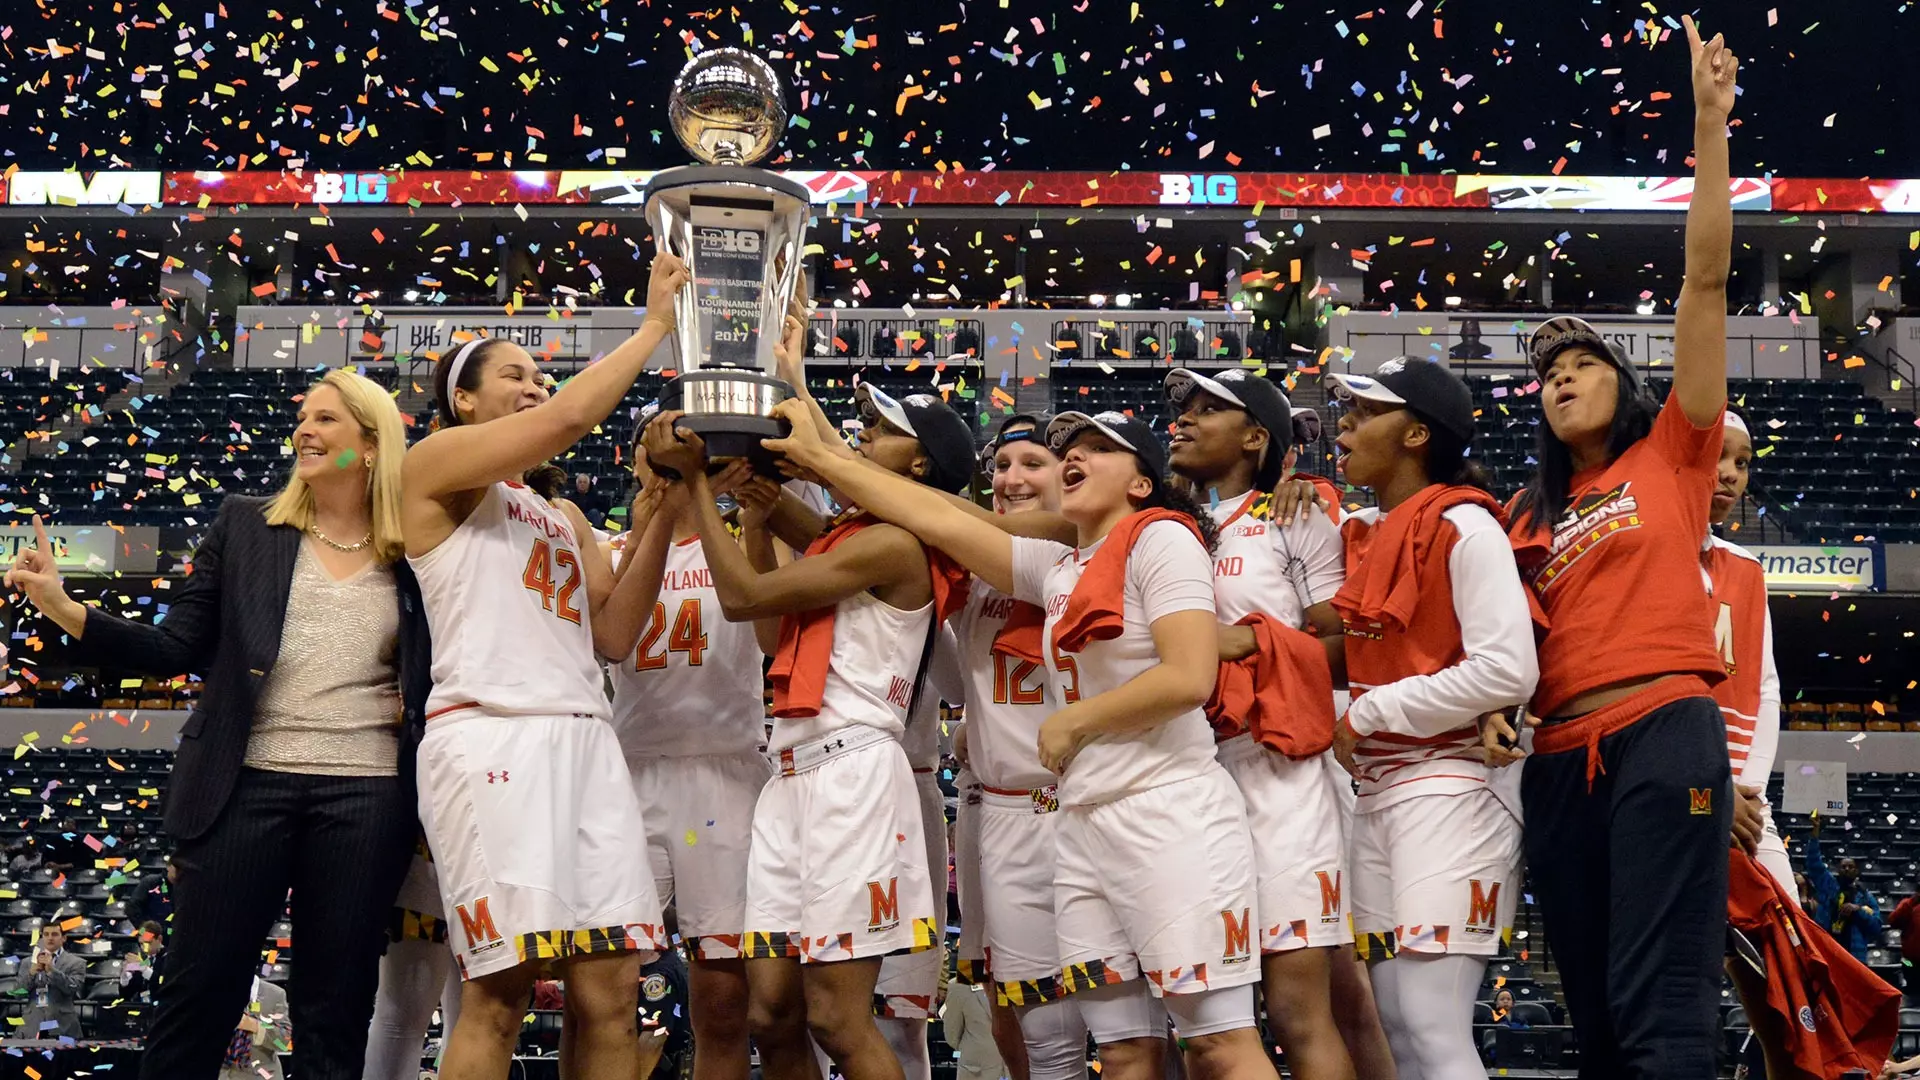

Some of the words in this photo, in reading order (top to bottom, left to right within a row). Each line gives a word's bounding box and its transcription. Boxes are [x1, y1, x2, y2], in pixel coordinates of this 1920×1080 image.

[715, 330, 748, 343] 2017
[522, 538, 582, 627] 42
[635, 598, 709, 673] 24
[1689, 787, 1712, 811] M
[866, 876, 900, 926] M
[1314, 869, 1342, 917] M
[1466, 878, 1502, 928] M
[455, 895, 503, 949] M
[1220, 907, 1251, 958] M
